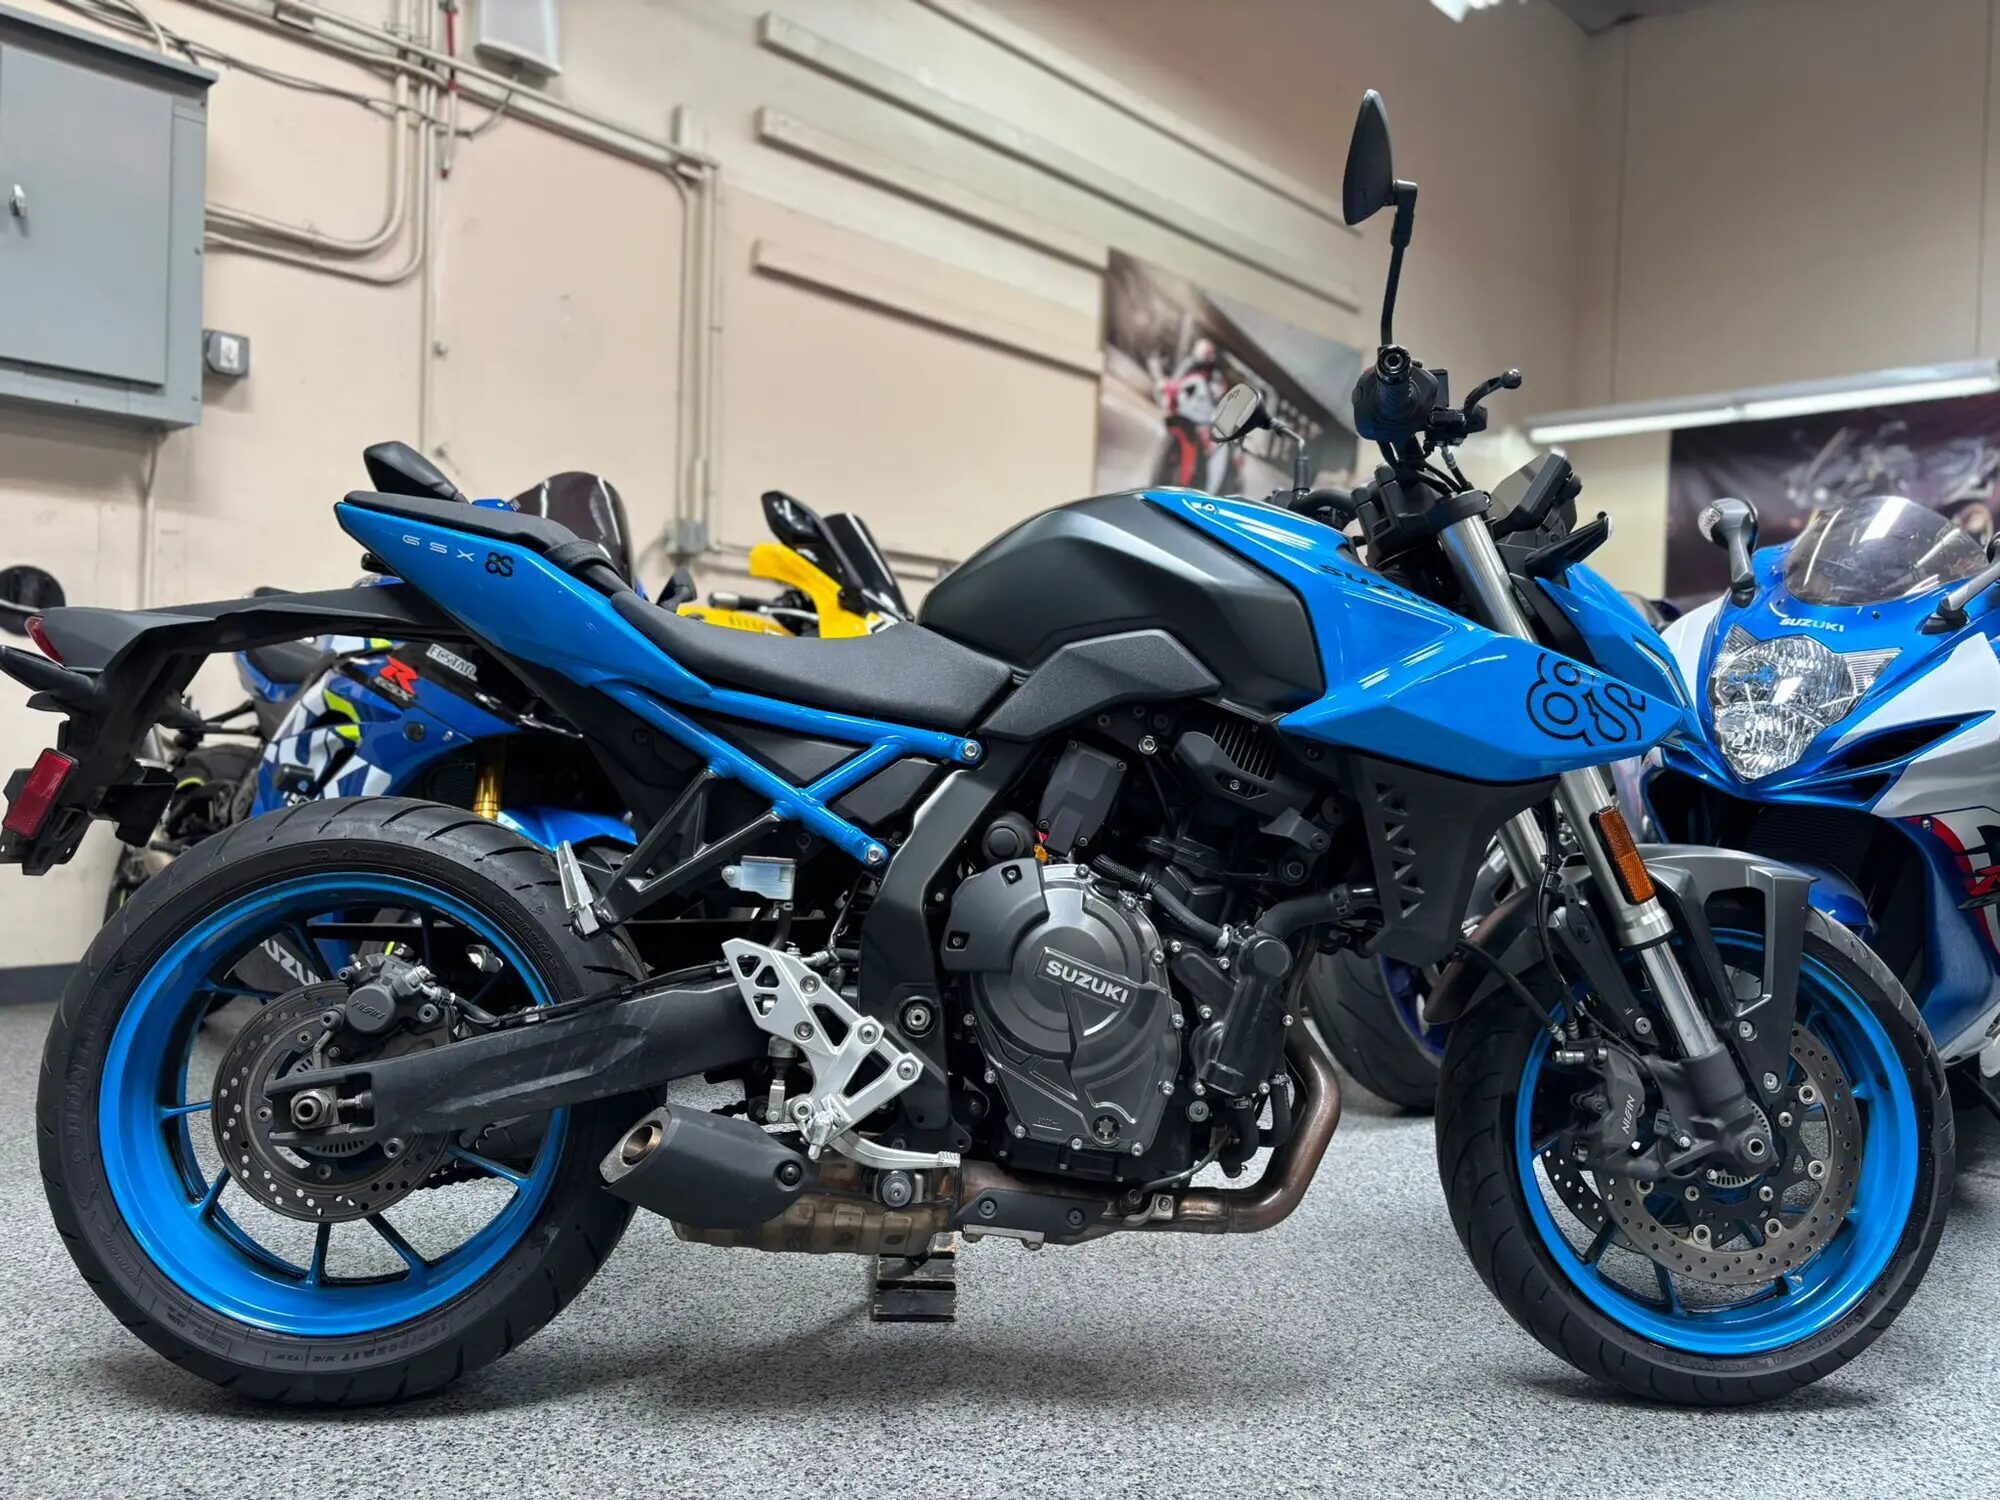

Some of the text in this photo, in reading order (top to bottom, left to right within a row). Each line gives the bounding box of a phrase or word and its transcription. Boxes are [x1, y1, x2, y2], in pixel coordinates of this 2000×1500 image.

[1779, 617, 1845, 633] SUZUKI
[425, 643, 478, 682] ECSTAR
[1046, 959, 1129, 1004] SUZUKI
